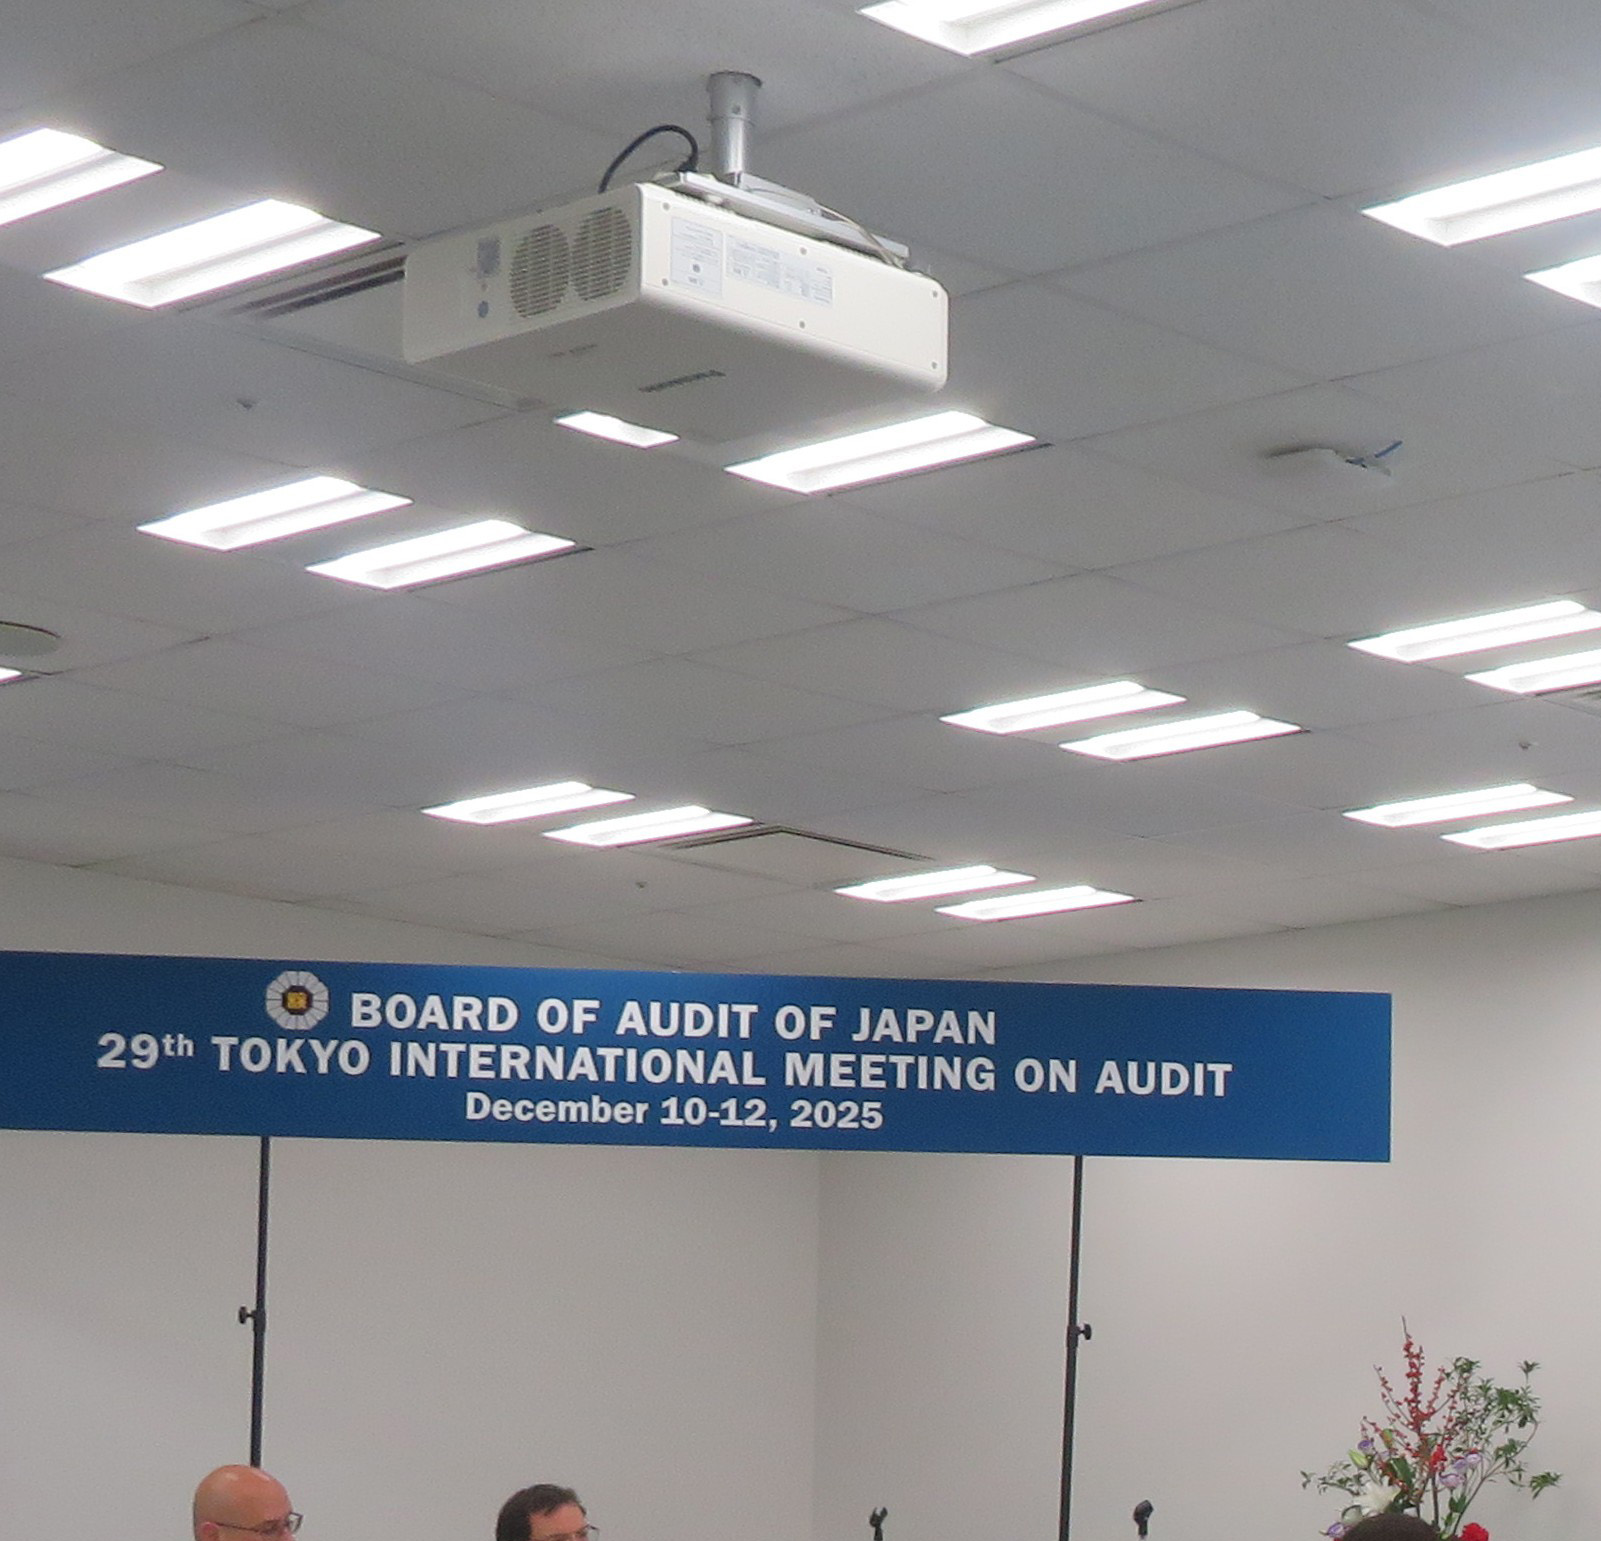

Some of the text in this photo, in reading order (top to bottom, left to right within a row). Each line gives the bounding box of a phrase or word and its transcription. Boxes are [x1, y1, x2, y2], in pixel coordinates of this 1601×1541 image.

[350, 991, 996, 1045] BOARD OF AUDIT OF JAPAN
[97, 1032, 1233, 1097] 29th TOKYO INTERNATIONAL MEETING ON AUDIT
[465, 1091, 884, 1133] December 10-12, 2025
